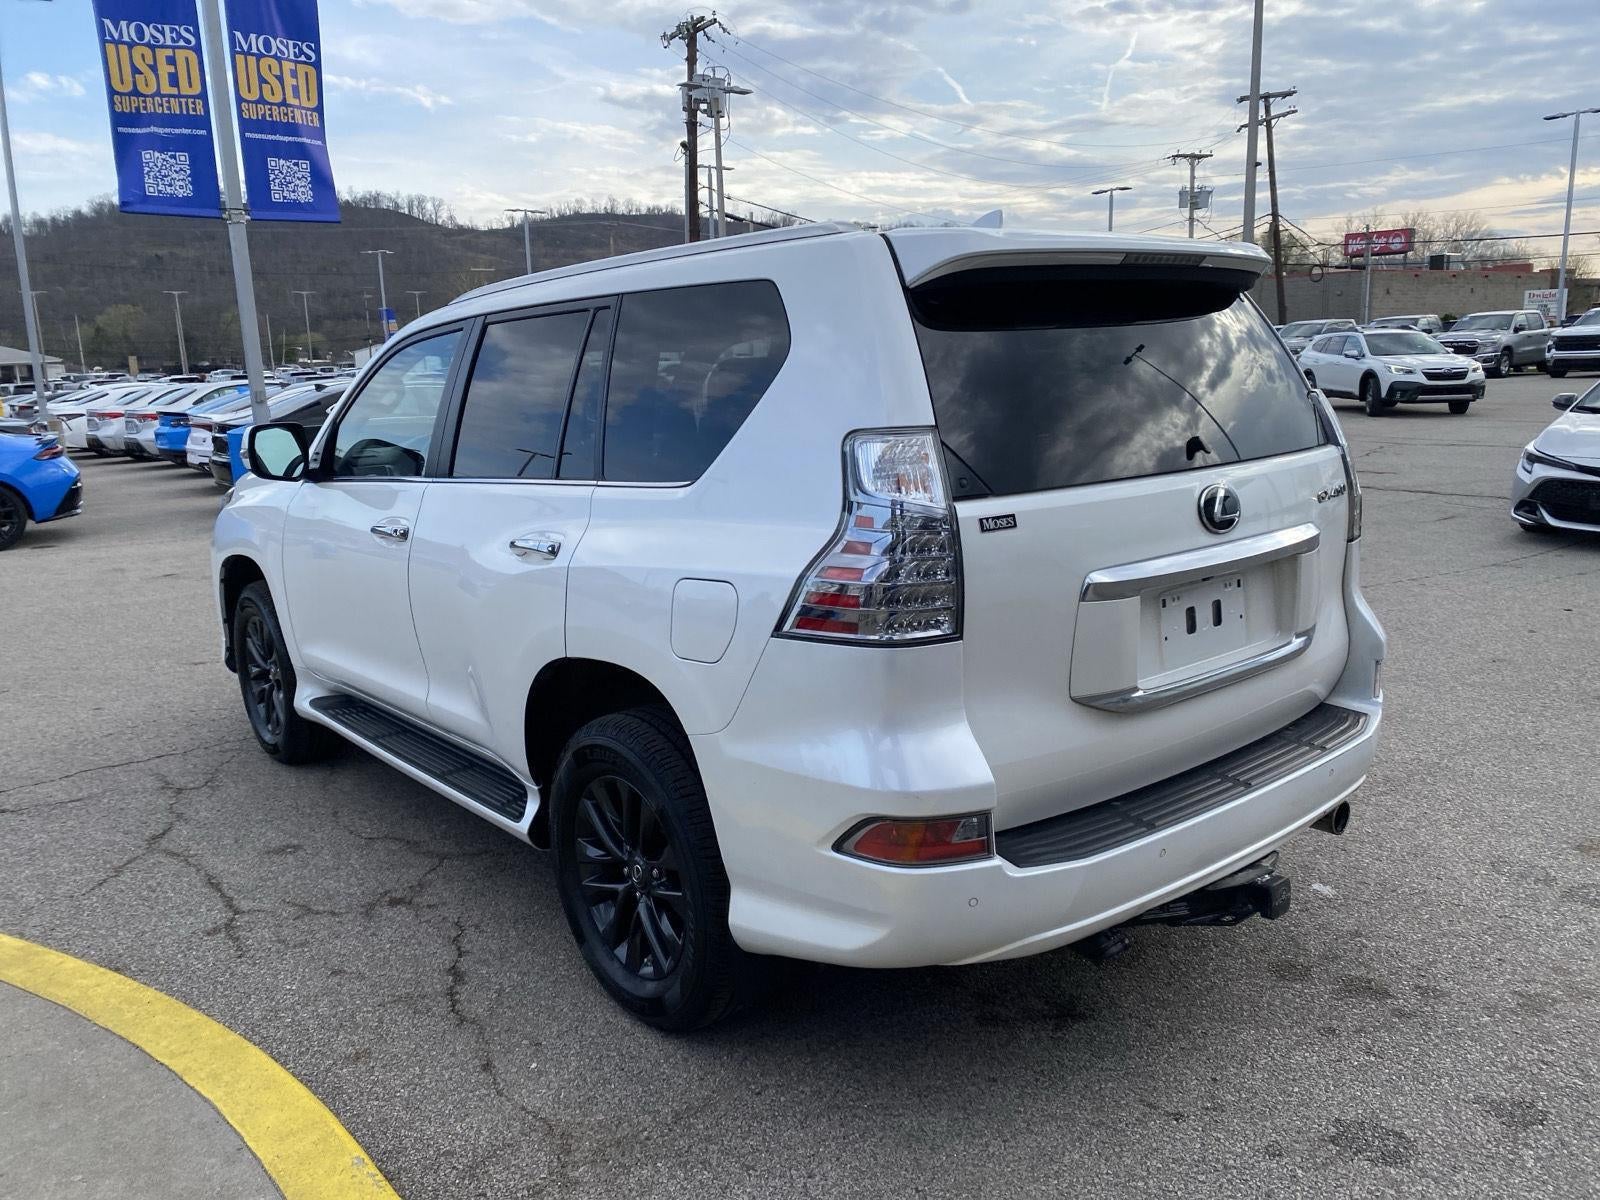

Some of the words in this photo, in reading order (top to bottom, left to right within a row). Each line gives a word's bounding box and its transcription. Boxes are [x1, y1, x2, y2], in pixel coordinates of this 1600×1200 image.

[102, 18, 195, 46] MOSES
[233, 31, 316, 62] MOSES
[105, 43, 201, 95] USED
[235, 54, 319, 109] USED
[114, 95, 204, 116] SUPERCENTER
[241, 102, 320, 128] SUPERCENTER
